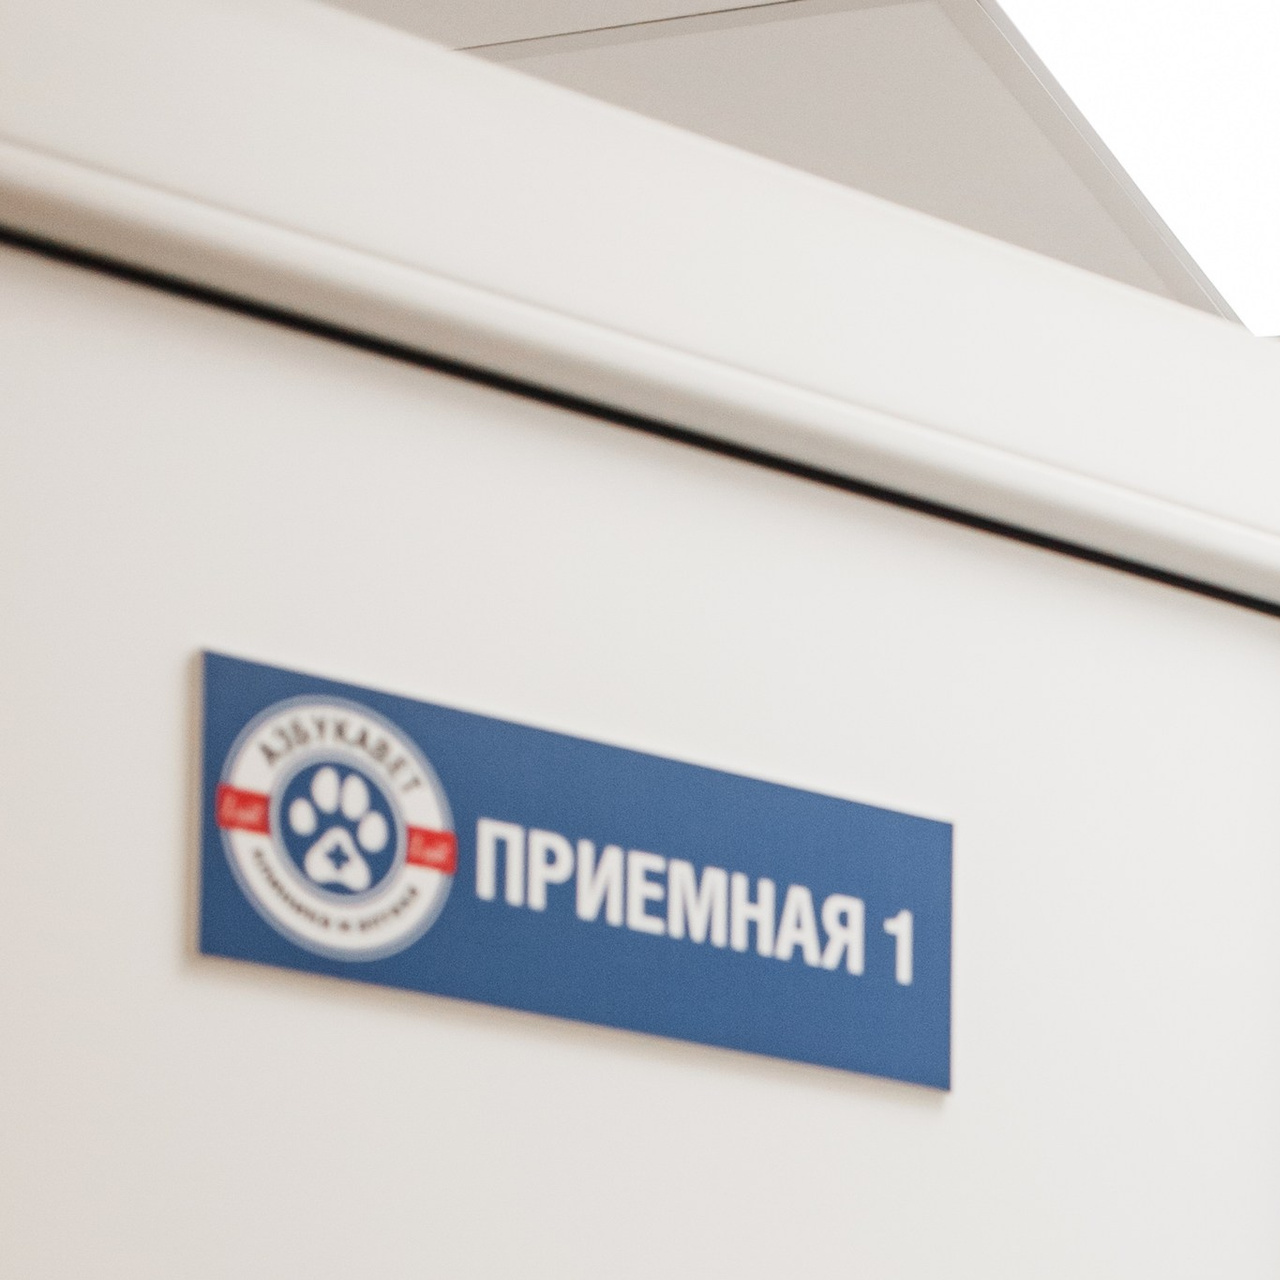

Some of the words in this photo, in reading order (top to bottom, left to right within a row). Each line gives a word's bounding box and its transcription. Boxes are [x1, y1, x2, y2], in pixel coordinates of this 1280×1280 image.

[259, 717, 422, 793] АЗБУКАВЕТ
[476, 818, 866, 976] ПРИЕМНАЯ
[883, 909, 914, 986] 1
